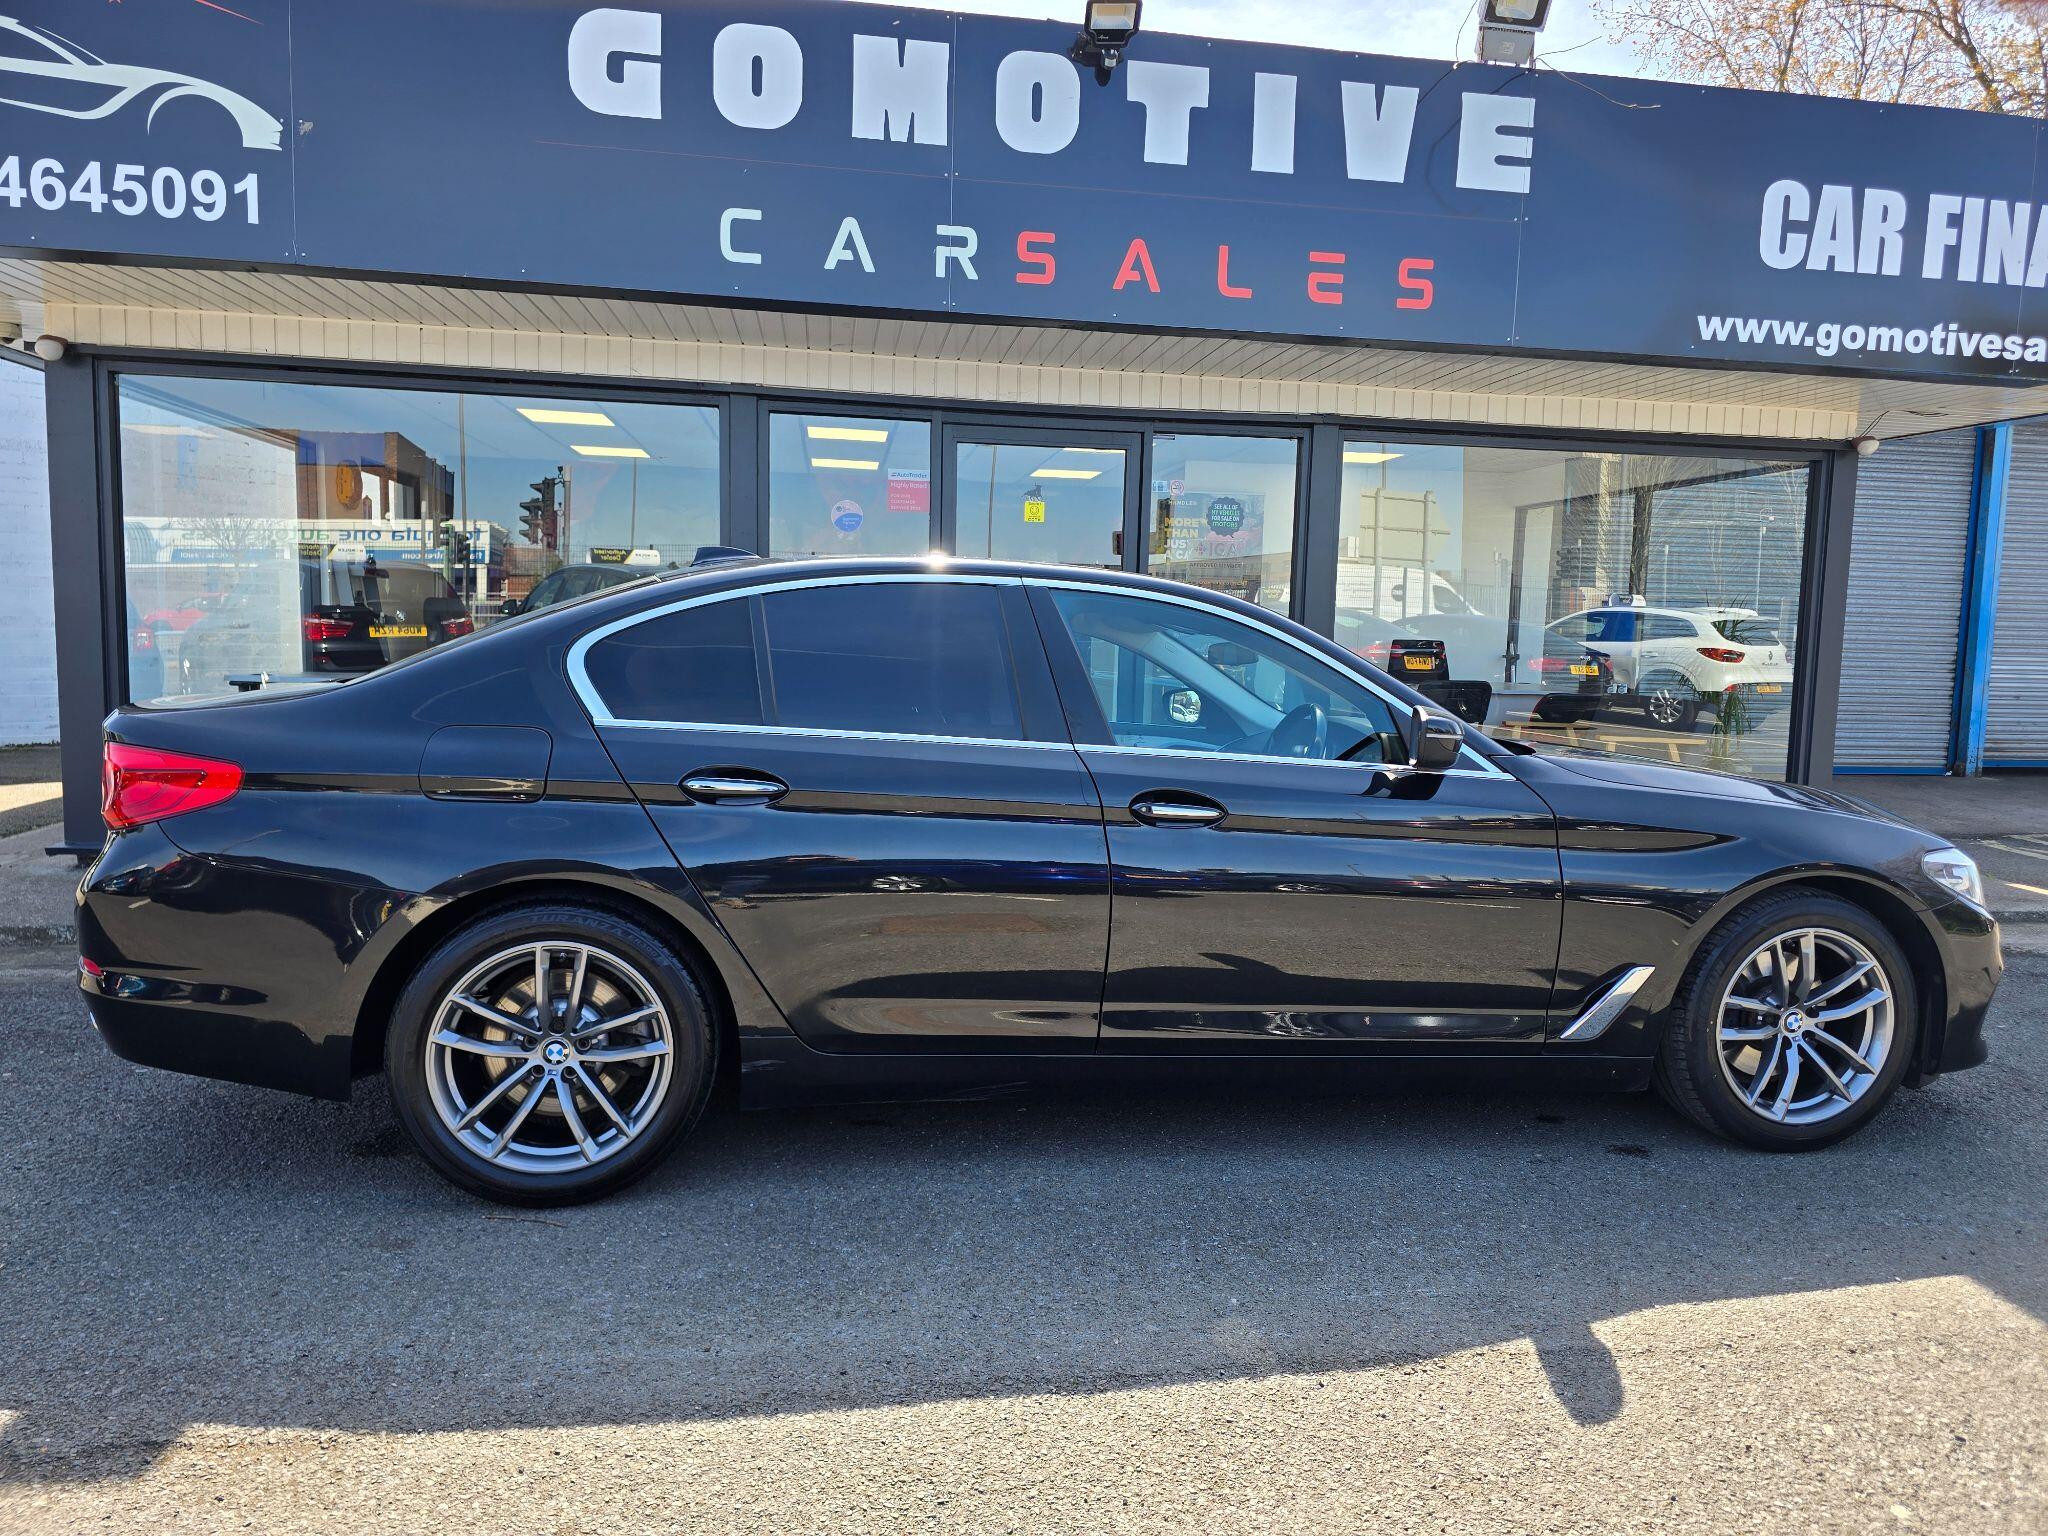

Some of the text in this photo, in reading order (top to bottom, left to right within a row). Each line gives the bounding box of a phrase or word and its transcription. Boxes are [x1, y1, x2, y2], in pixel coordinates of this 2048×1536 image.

[568, 8, 1536, 194] GOMOTIVE
[0, 155, 260, 225] 4645091
[1759, 179, 1907, 277] CAR
[1697, 314, 2048, 363] www.gomotivesa
[1164, 528, 1199, 538] THAN
[1165, 518, 1201, 527] MORE
